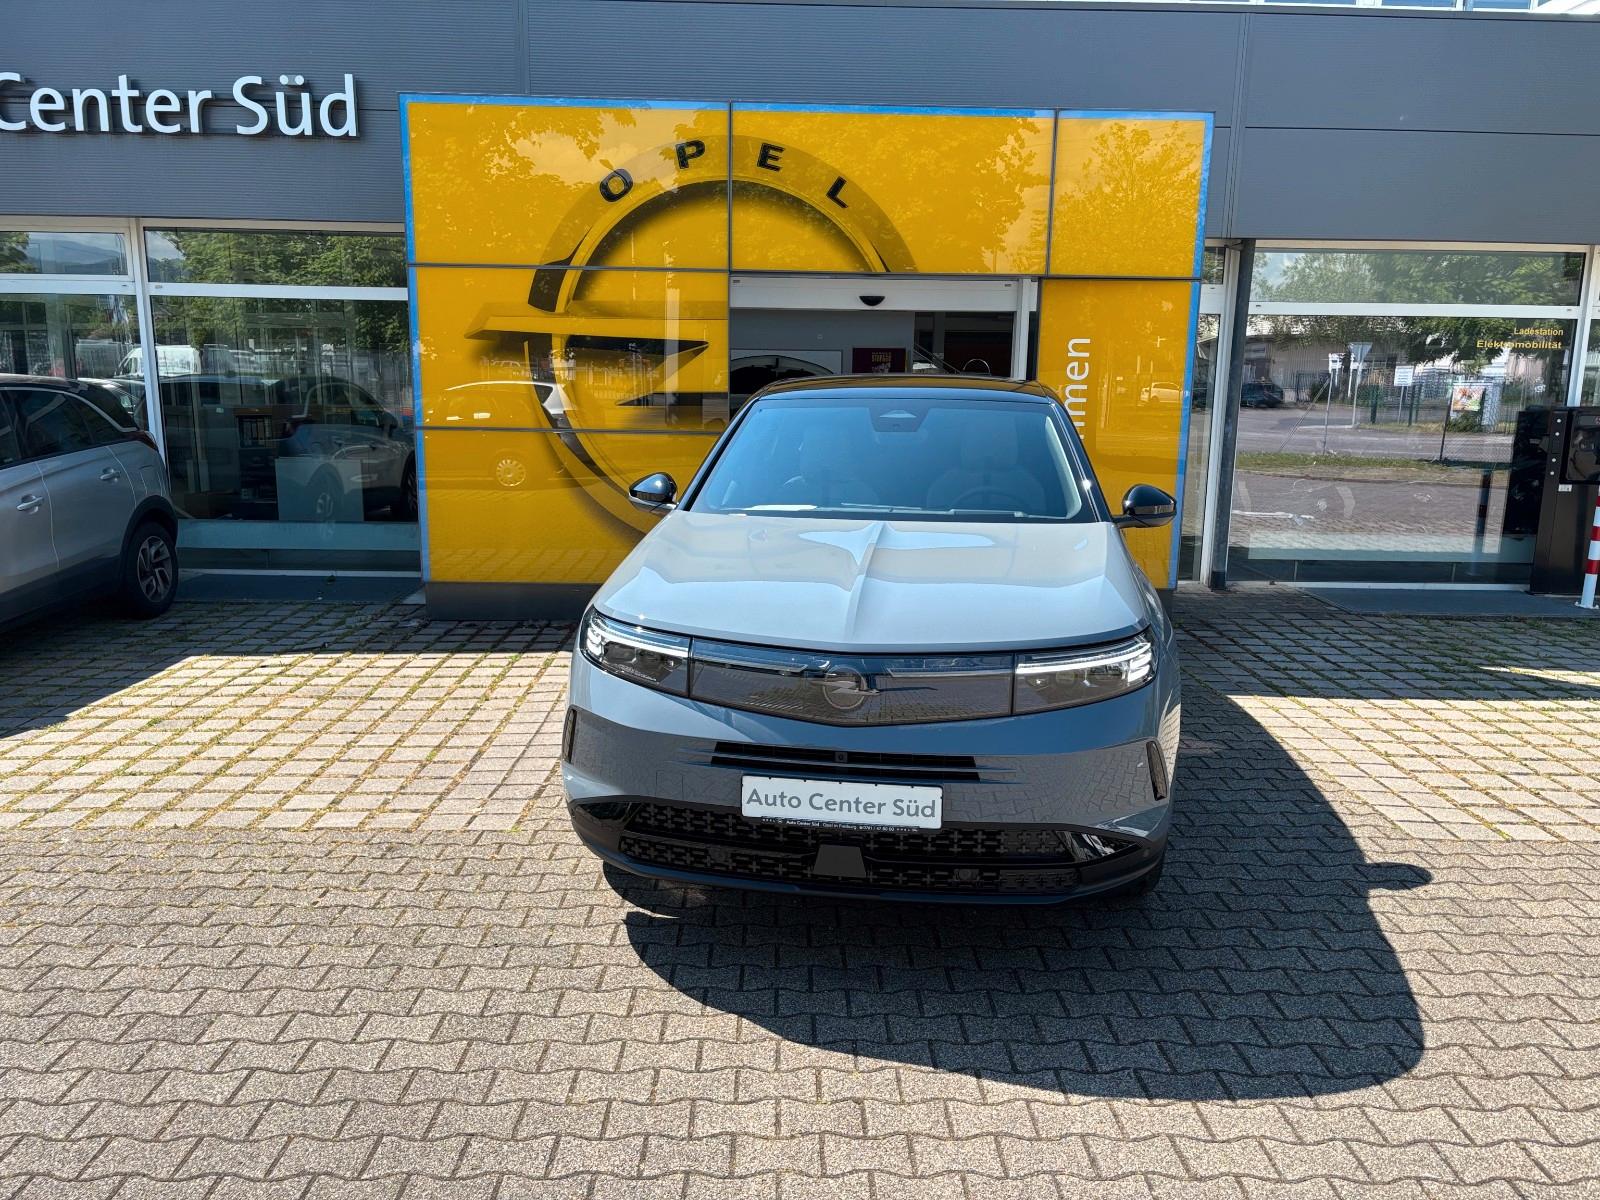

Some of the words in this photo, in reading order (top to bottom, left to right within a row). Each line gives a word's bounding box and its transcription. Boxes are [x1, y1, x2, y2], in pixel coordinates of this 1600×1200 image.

[0, 71, 213, 134] Center
[232, 73, 360, 137] Süd
[598, 138, 849, 209] OPEL
[1476, 340, 1562, 349] Elektromobilität
[1513, 327, 1564, 336] Ladestation
[1064, 337, 1091, 440] men
[746, 788, 802, 809] Auto
[808, 793, 887, 815] Center
[892, 798, 936, 818] Süd
